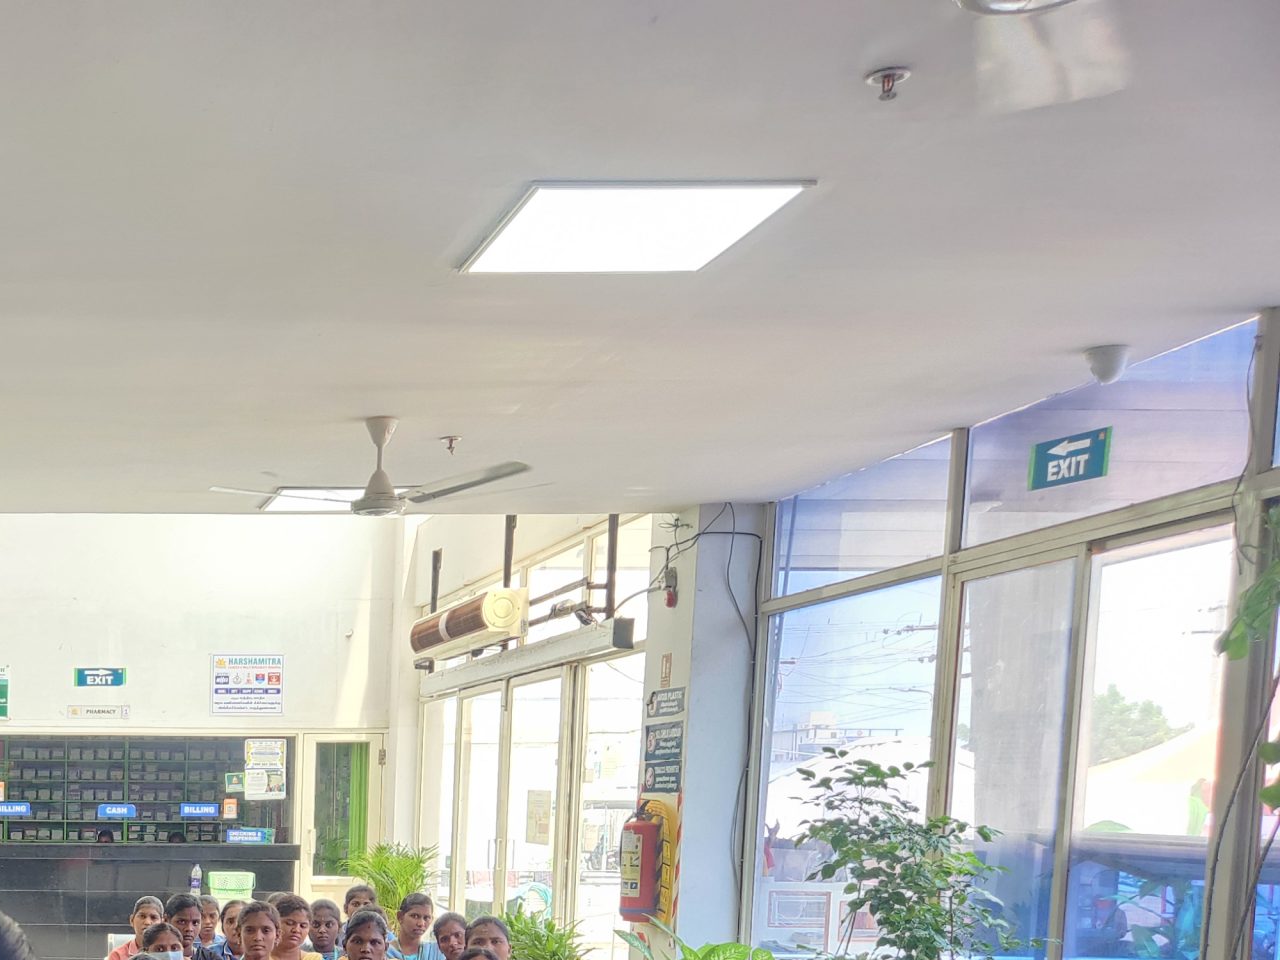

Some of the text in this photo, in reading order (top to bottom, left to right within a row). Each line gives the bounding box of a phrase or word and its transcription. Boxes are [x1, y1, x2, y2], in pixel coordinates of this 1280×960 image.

[1047, 453, 1090, 482] EXIT
[228, 657, 281, 665] HARSHAMITRA
[86, 675, 114, 685] EXIT
[106, 806, 128, 814] CASH
[184, 806, 215, 814] BILLING
